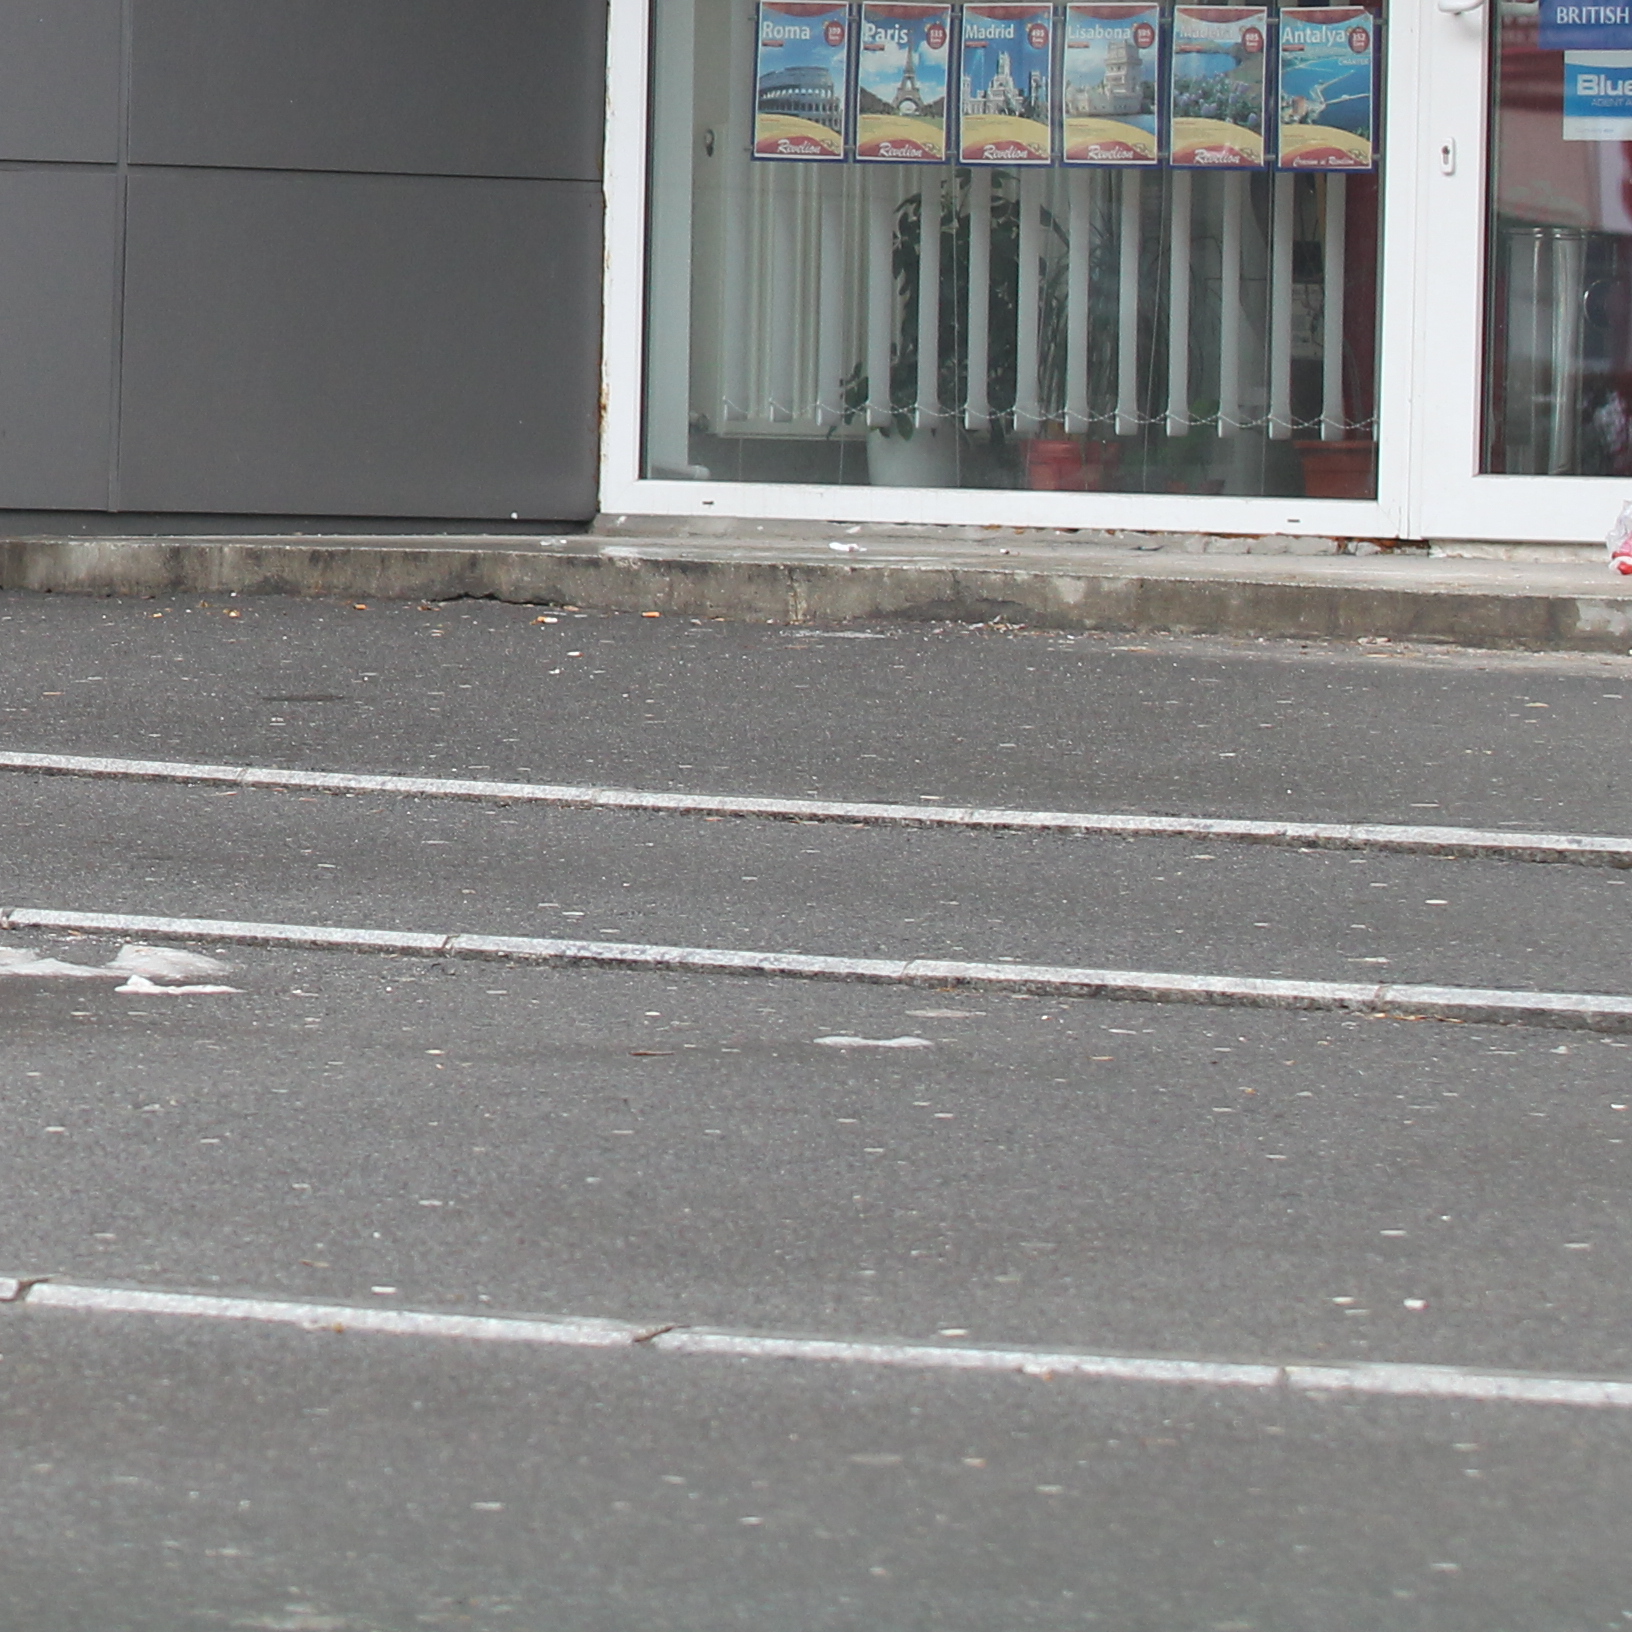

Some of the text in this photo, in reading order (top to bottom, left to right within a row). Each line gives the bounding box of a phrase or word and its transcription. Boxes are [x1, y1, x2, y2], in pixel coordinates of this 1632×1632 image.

[1557, 6, 1629, 24] BRITISH
[762, 21, 811, 39] Roma
[864, 23, 909, 44] Paris
[965, 24, 1015, 39] Madrid
[1068, 24, 1131, 39] Lisabona
[1282, 25, 1346, 46] Antalya
